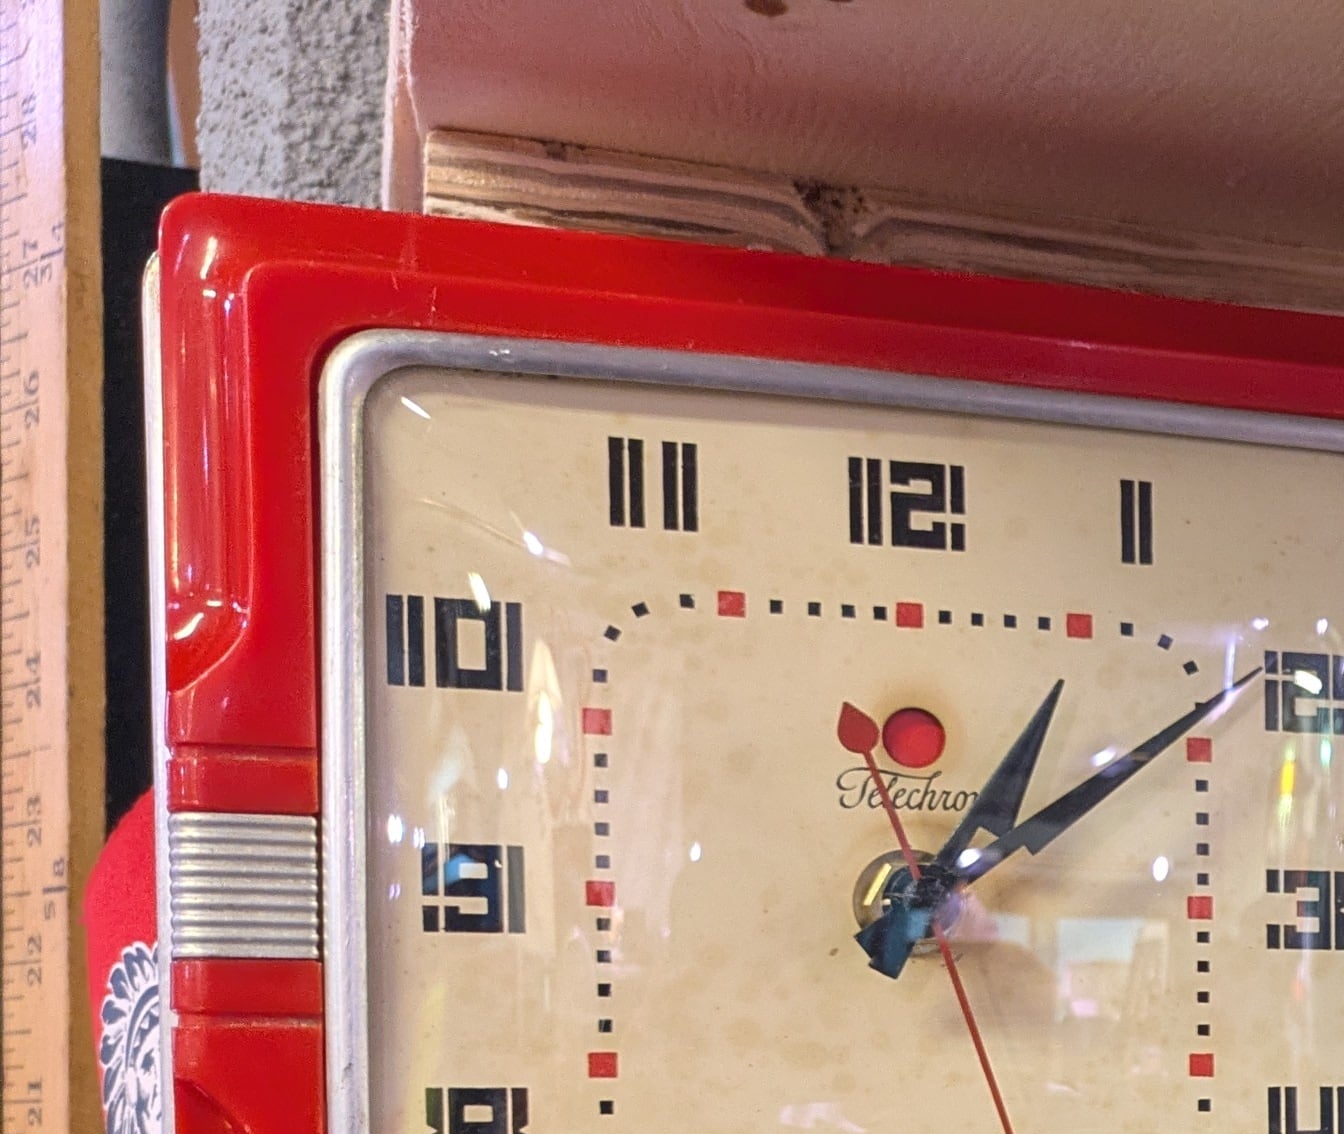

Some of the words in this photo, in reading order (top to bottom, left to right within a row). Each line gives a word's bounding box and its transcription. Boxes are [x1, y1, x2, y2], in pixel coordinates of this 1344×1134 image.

[23, 238, 39, 289] 27
[24, 369, 41, 430] 26
[608, 437, 698, 532] 11
[847, 456, 966, 552] 12
[24, 515, 41, 568] 25
[1119, 479, 1153, 566] 1
[385, 594, 524, 692] 10
[26, 653, 41, 709] 24
[26, 794, 42, 847] 23
[421, 842, 526, 933] 9
[26, 934, 42, 986] 22
[27, 1077, 42, 1127] 21
